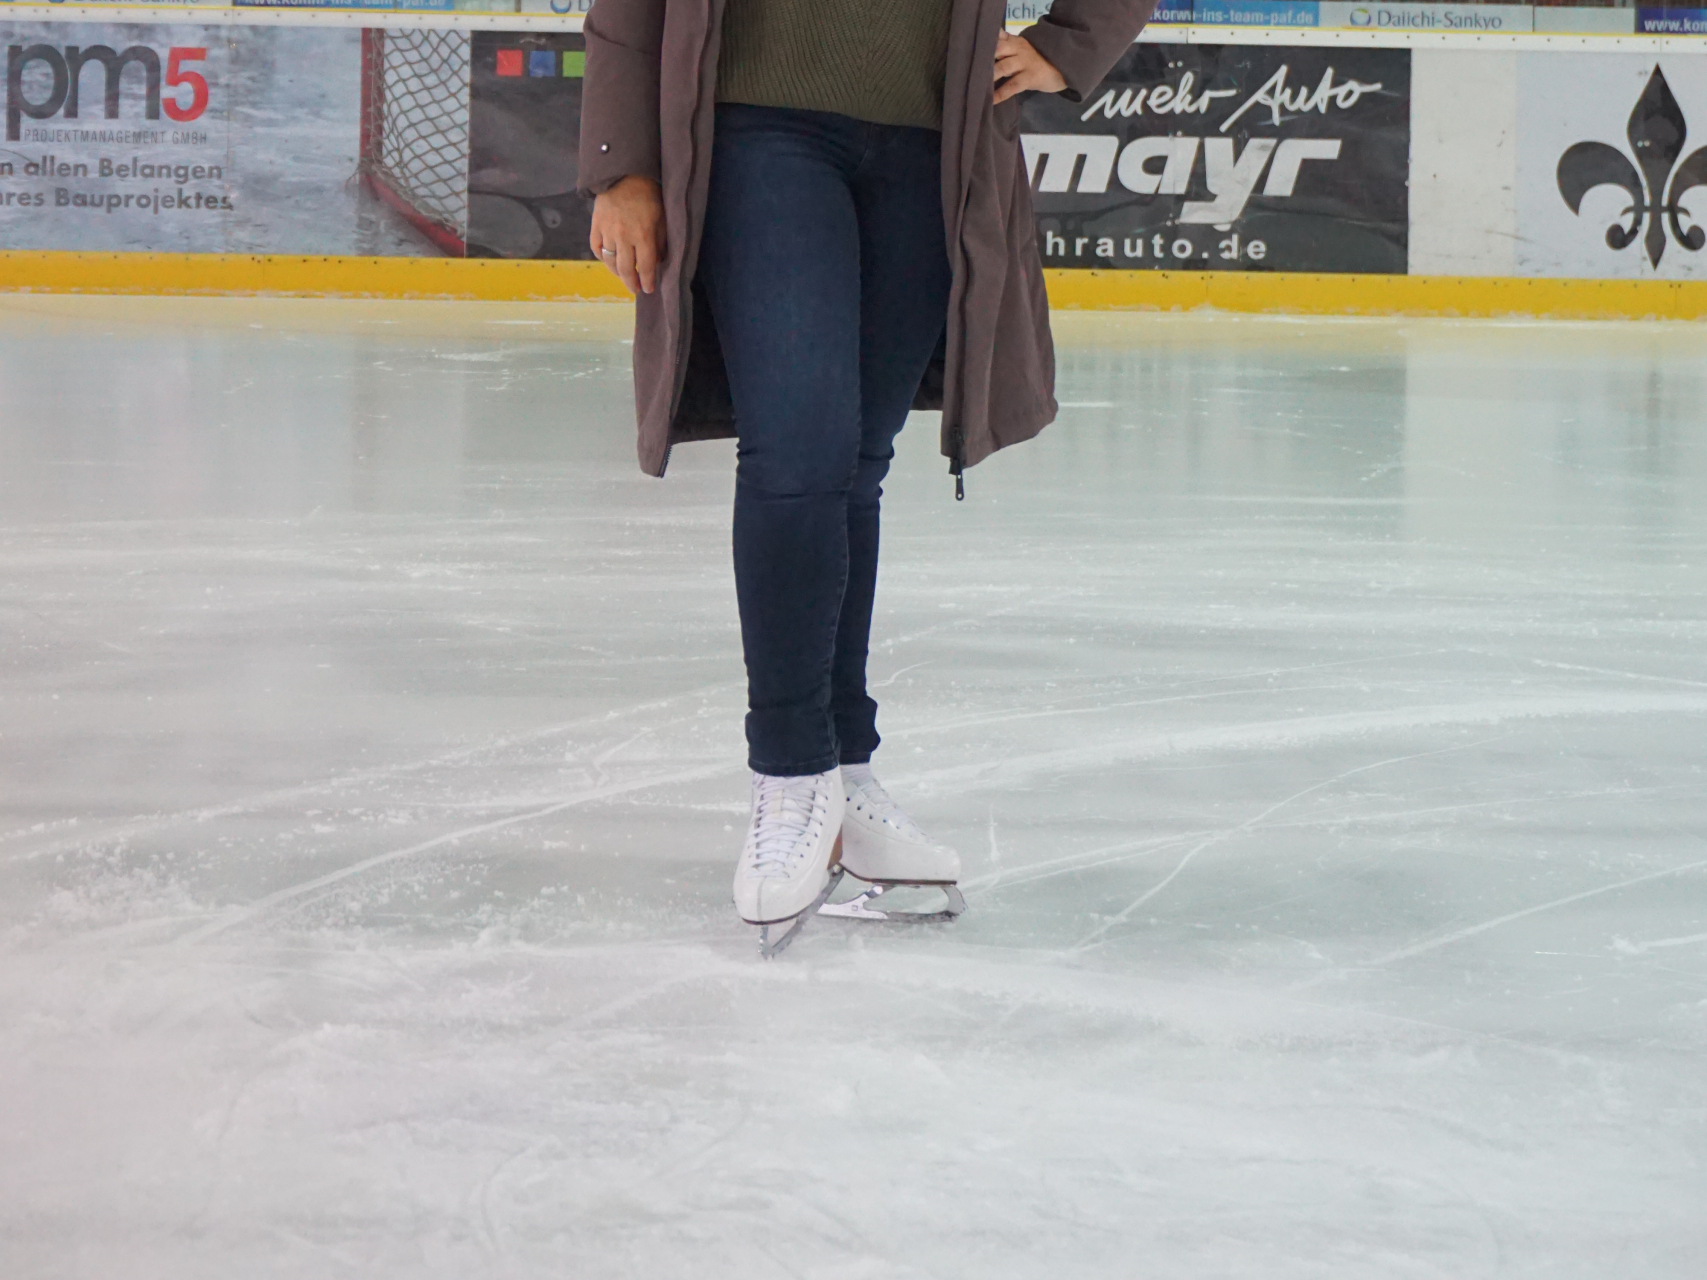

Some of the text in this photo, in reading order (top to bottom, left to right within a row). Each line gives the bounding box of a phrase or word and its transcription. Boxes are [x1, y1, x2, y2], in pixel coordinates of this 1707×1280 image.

[1377, 9, 1503, 30] Daiichi-Sankyo
[6, 43, 209, 141] pm5
[1080, 64, 1382, 133] mehr Auto
[24, 129, 208, 144] PROJEKTMANAGEMENT GMBH
[23, 155, 88, 177] allen
[99, 157, 223, 184] Belangen
[1020, 133, 1342, 225] mayr
[54, 187, 234, 214] Bauprojektes
[1045, 230, 1267, 260] hrauto.de
